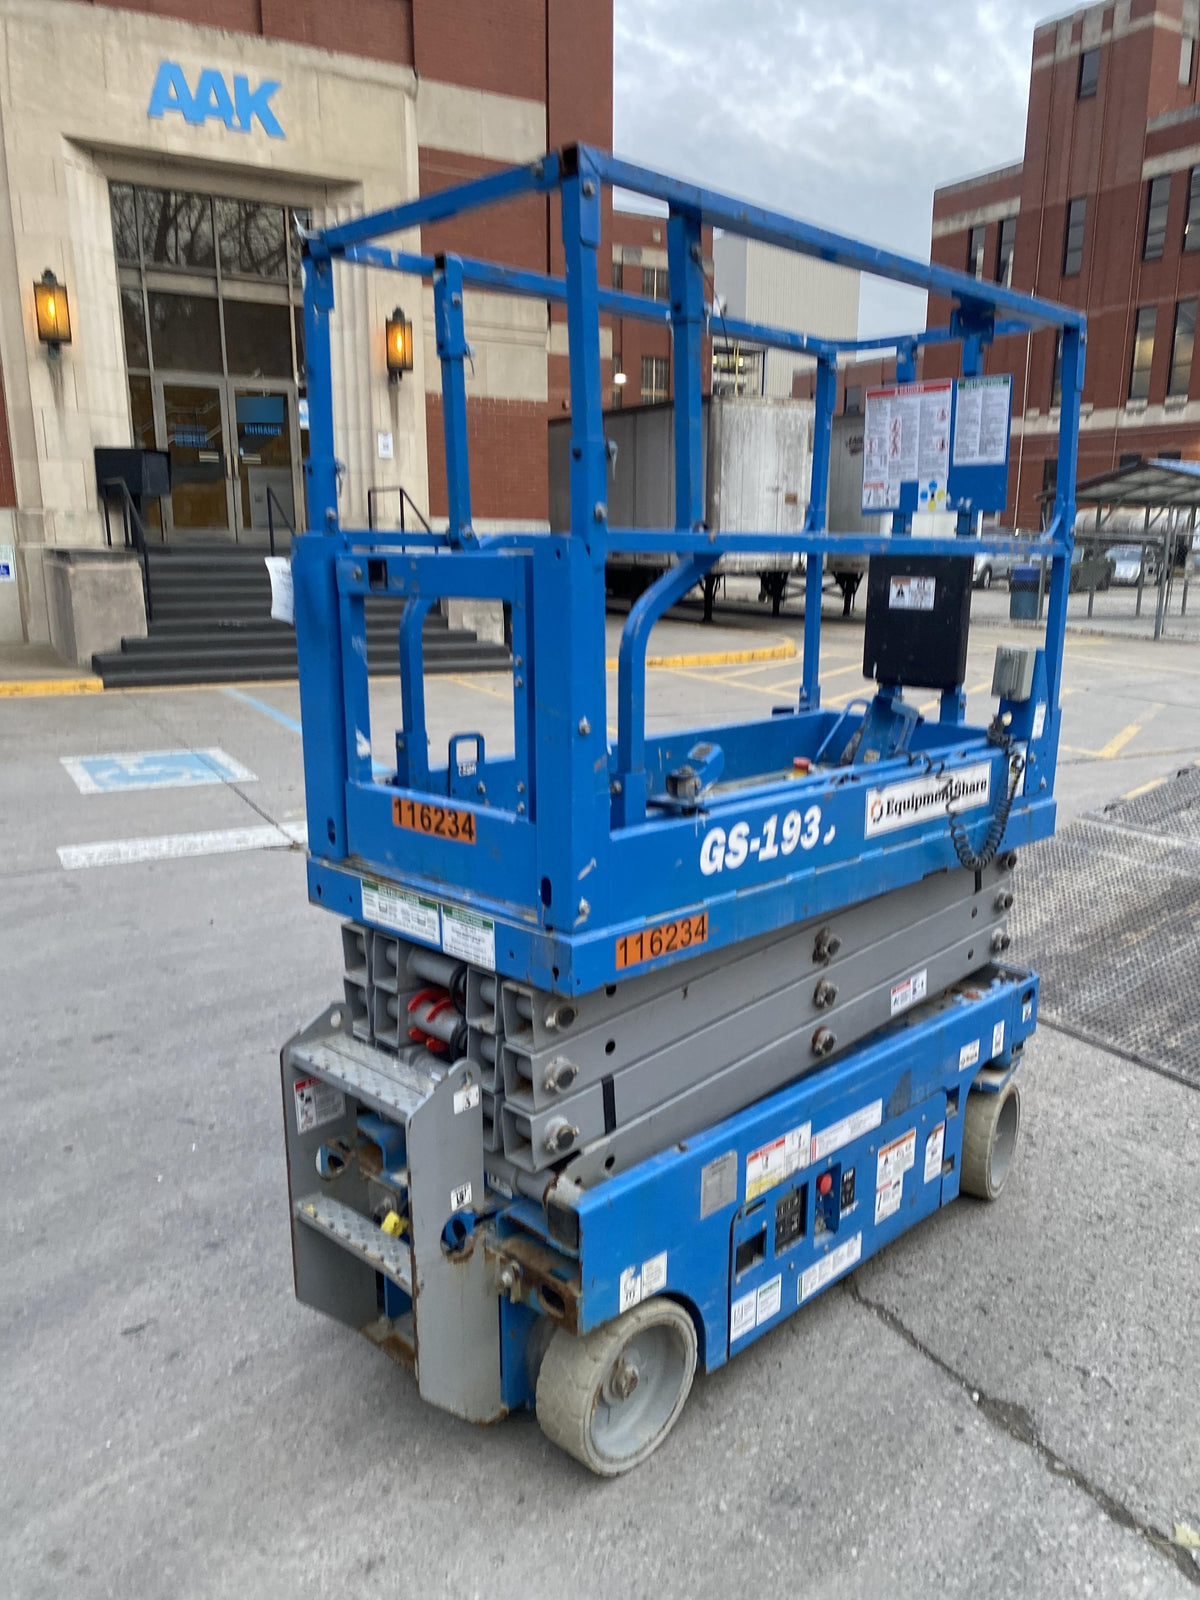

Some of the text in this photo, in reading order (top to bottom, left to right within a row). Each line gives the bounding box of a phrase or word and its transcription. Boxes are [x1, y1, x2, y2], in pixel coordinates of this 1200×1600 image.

[148, 60, 286, 139] AAK
[393, 799, 475, 842] 116234
[886, 778, 987, 816] EquipmenShare
[699, 805, 835, 876] GS-193
[619, 912, 707, 967] 116234
